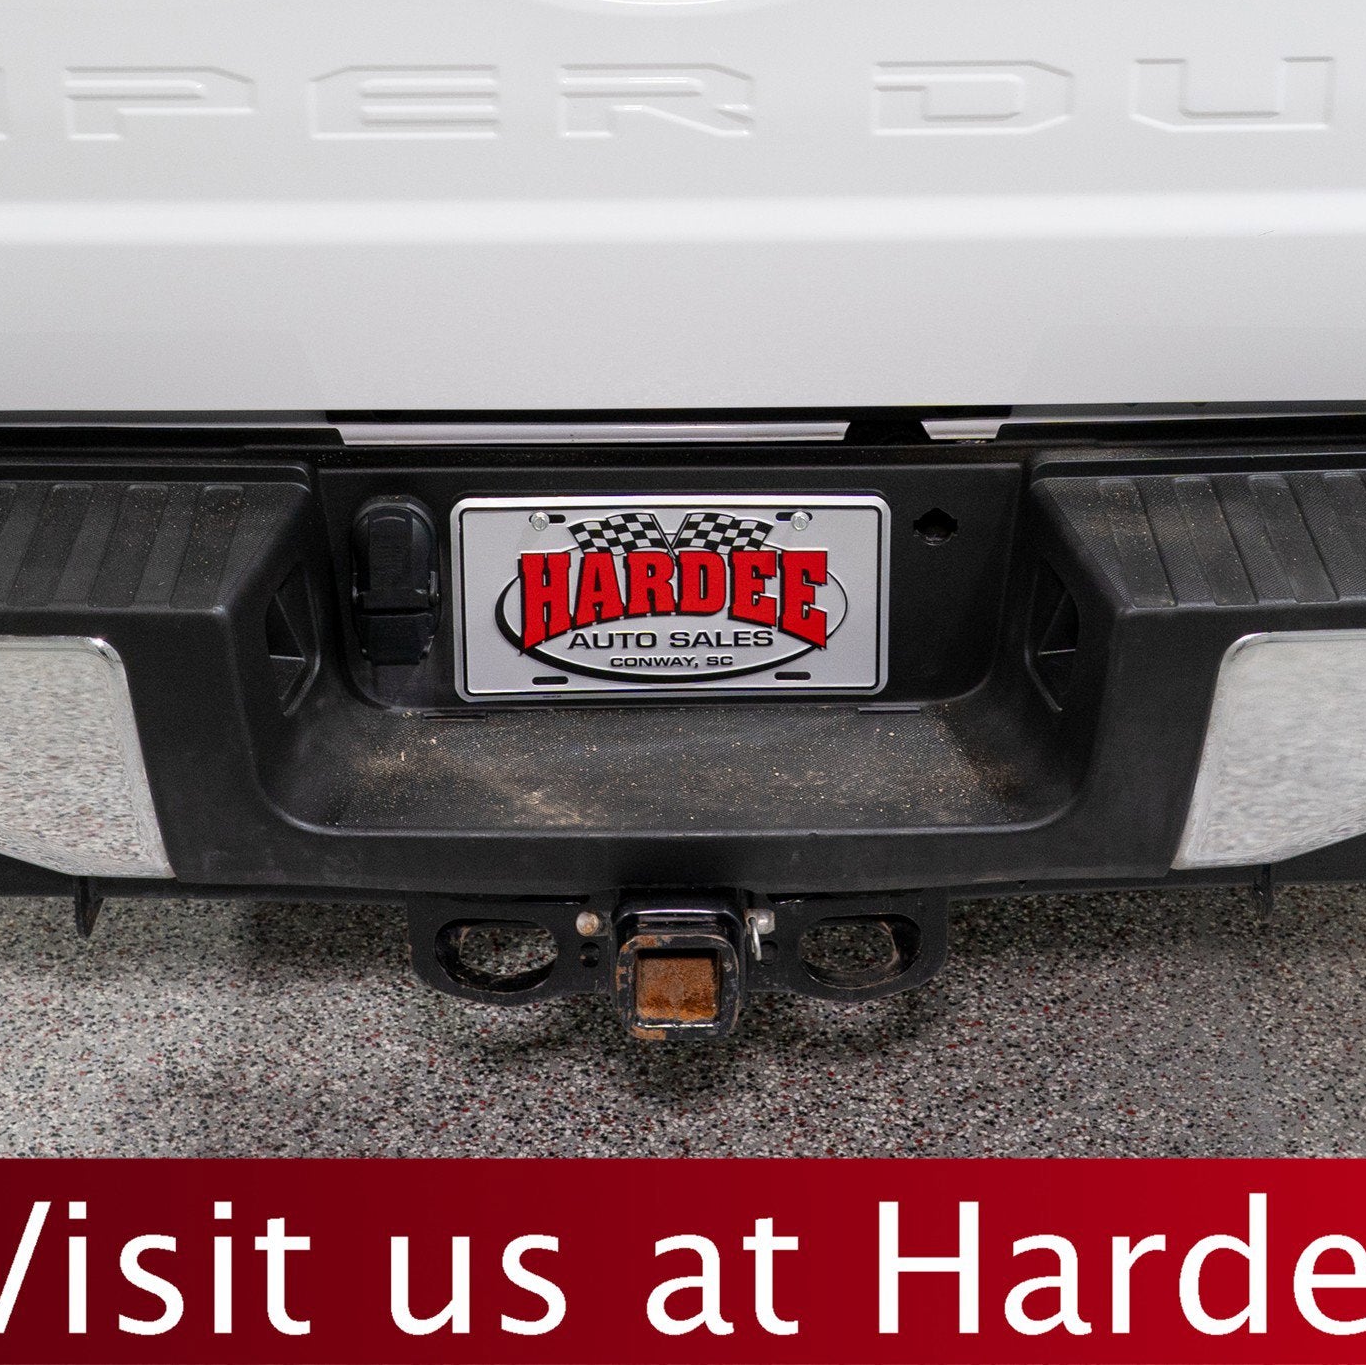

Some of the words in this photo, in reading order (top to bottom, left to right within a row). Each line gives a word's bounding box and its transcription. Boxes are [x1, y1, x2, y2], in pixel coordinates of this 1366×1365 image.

[518, 550, 827, 652] HARDEE
[567, 632, 657, 649] AUTO
[669, 630, 774, 648] SALES
[610, 656, 699, 669] CONWAY,
[707, 656, 734, 668] SC
